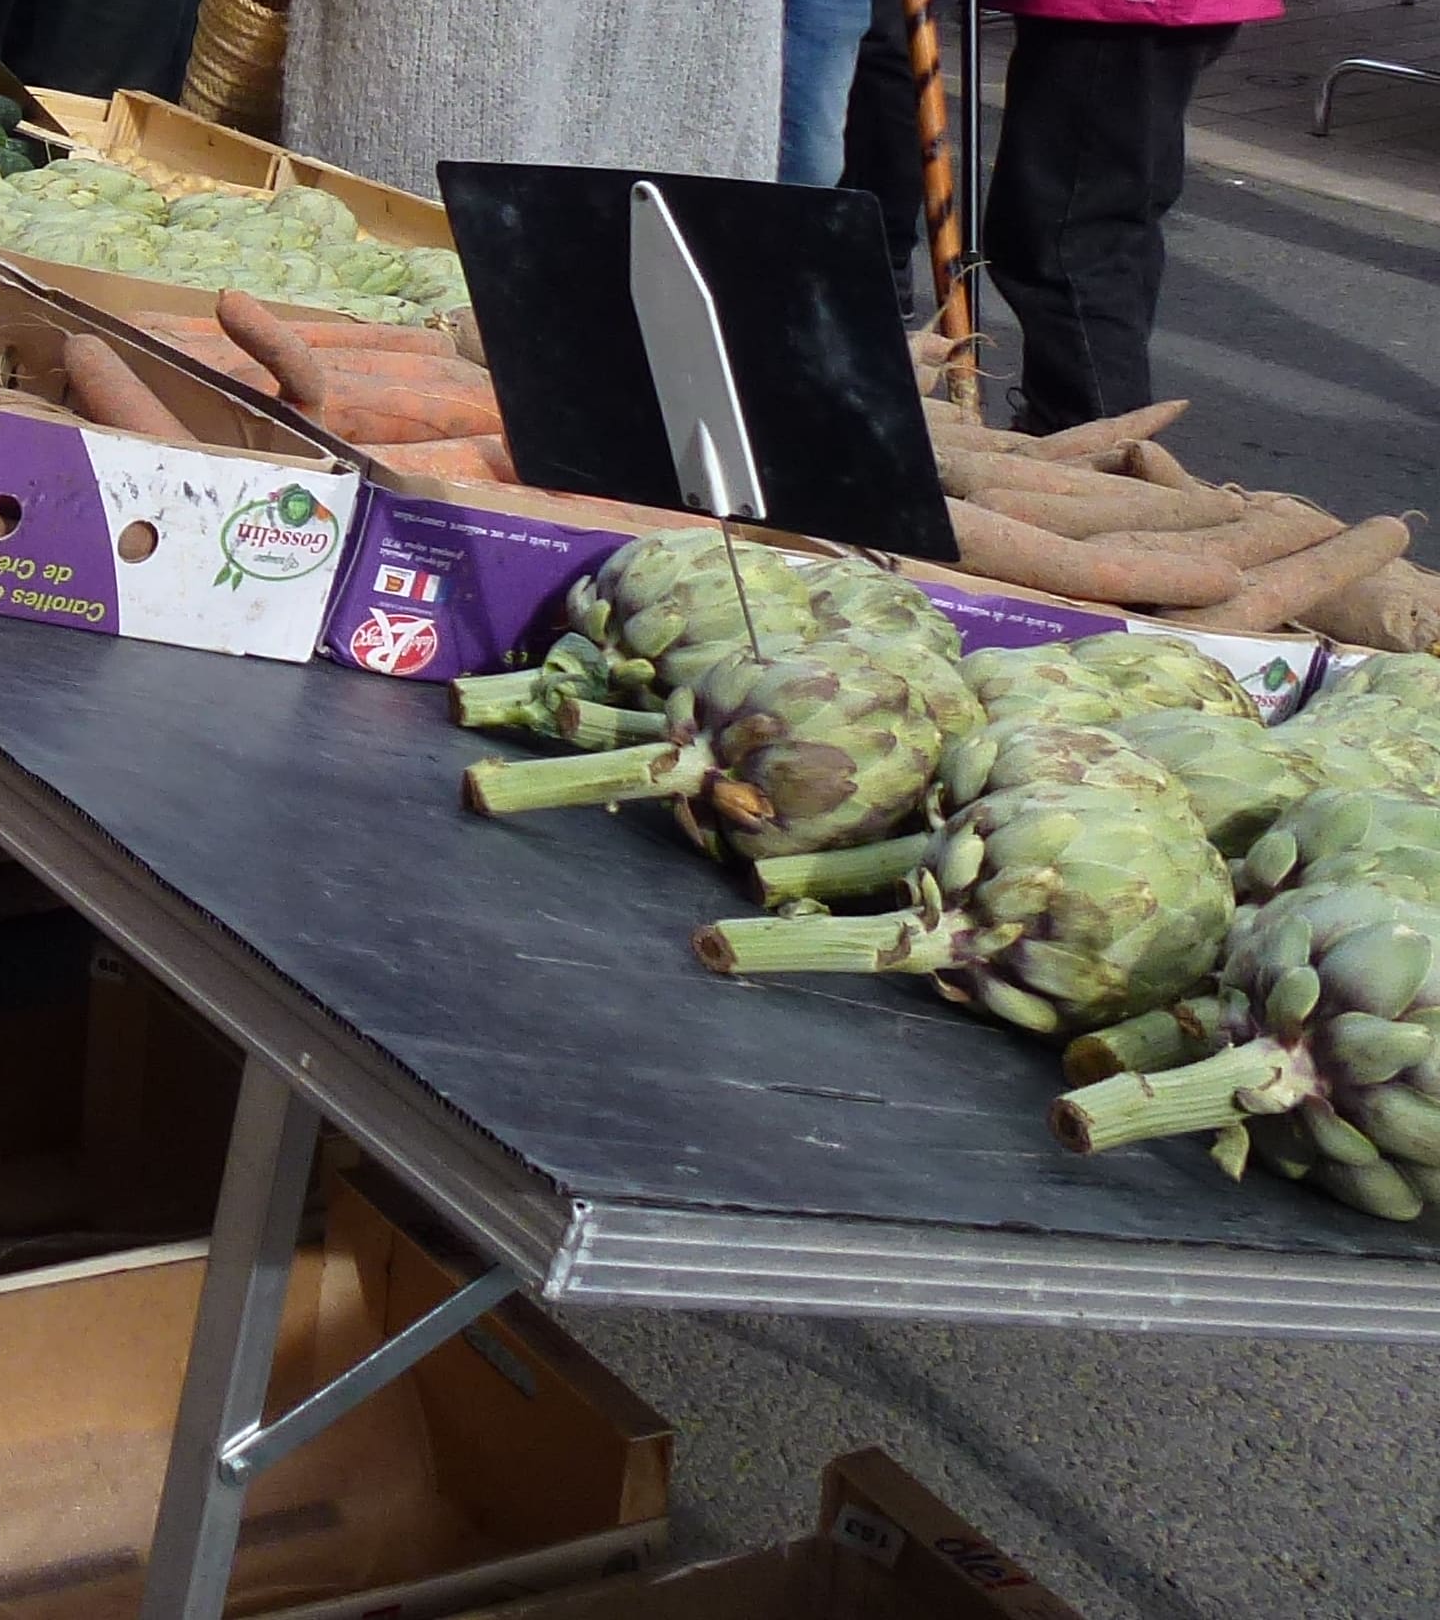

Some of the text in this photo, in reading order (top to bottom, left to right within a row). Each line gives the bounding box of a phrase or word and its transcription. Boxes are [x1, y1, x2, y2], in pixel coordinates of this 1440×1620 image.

[237, 522, 329, 554] Gosselin
[39, 561, 74, 583] de
[8, 580, 107, 622] Carottes
